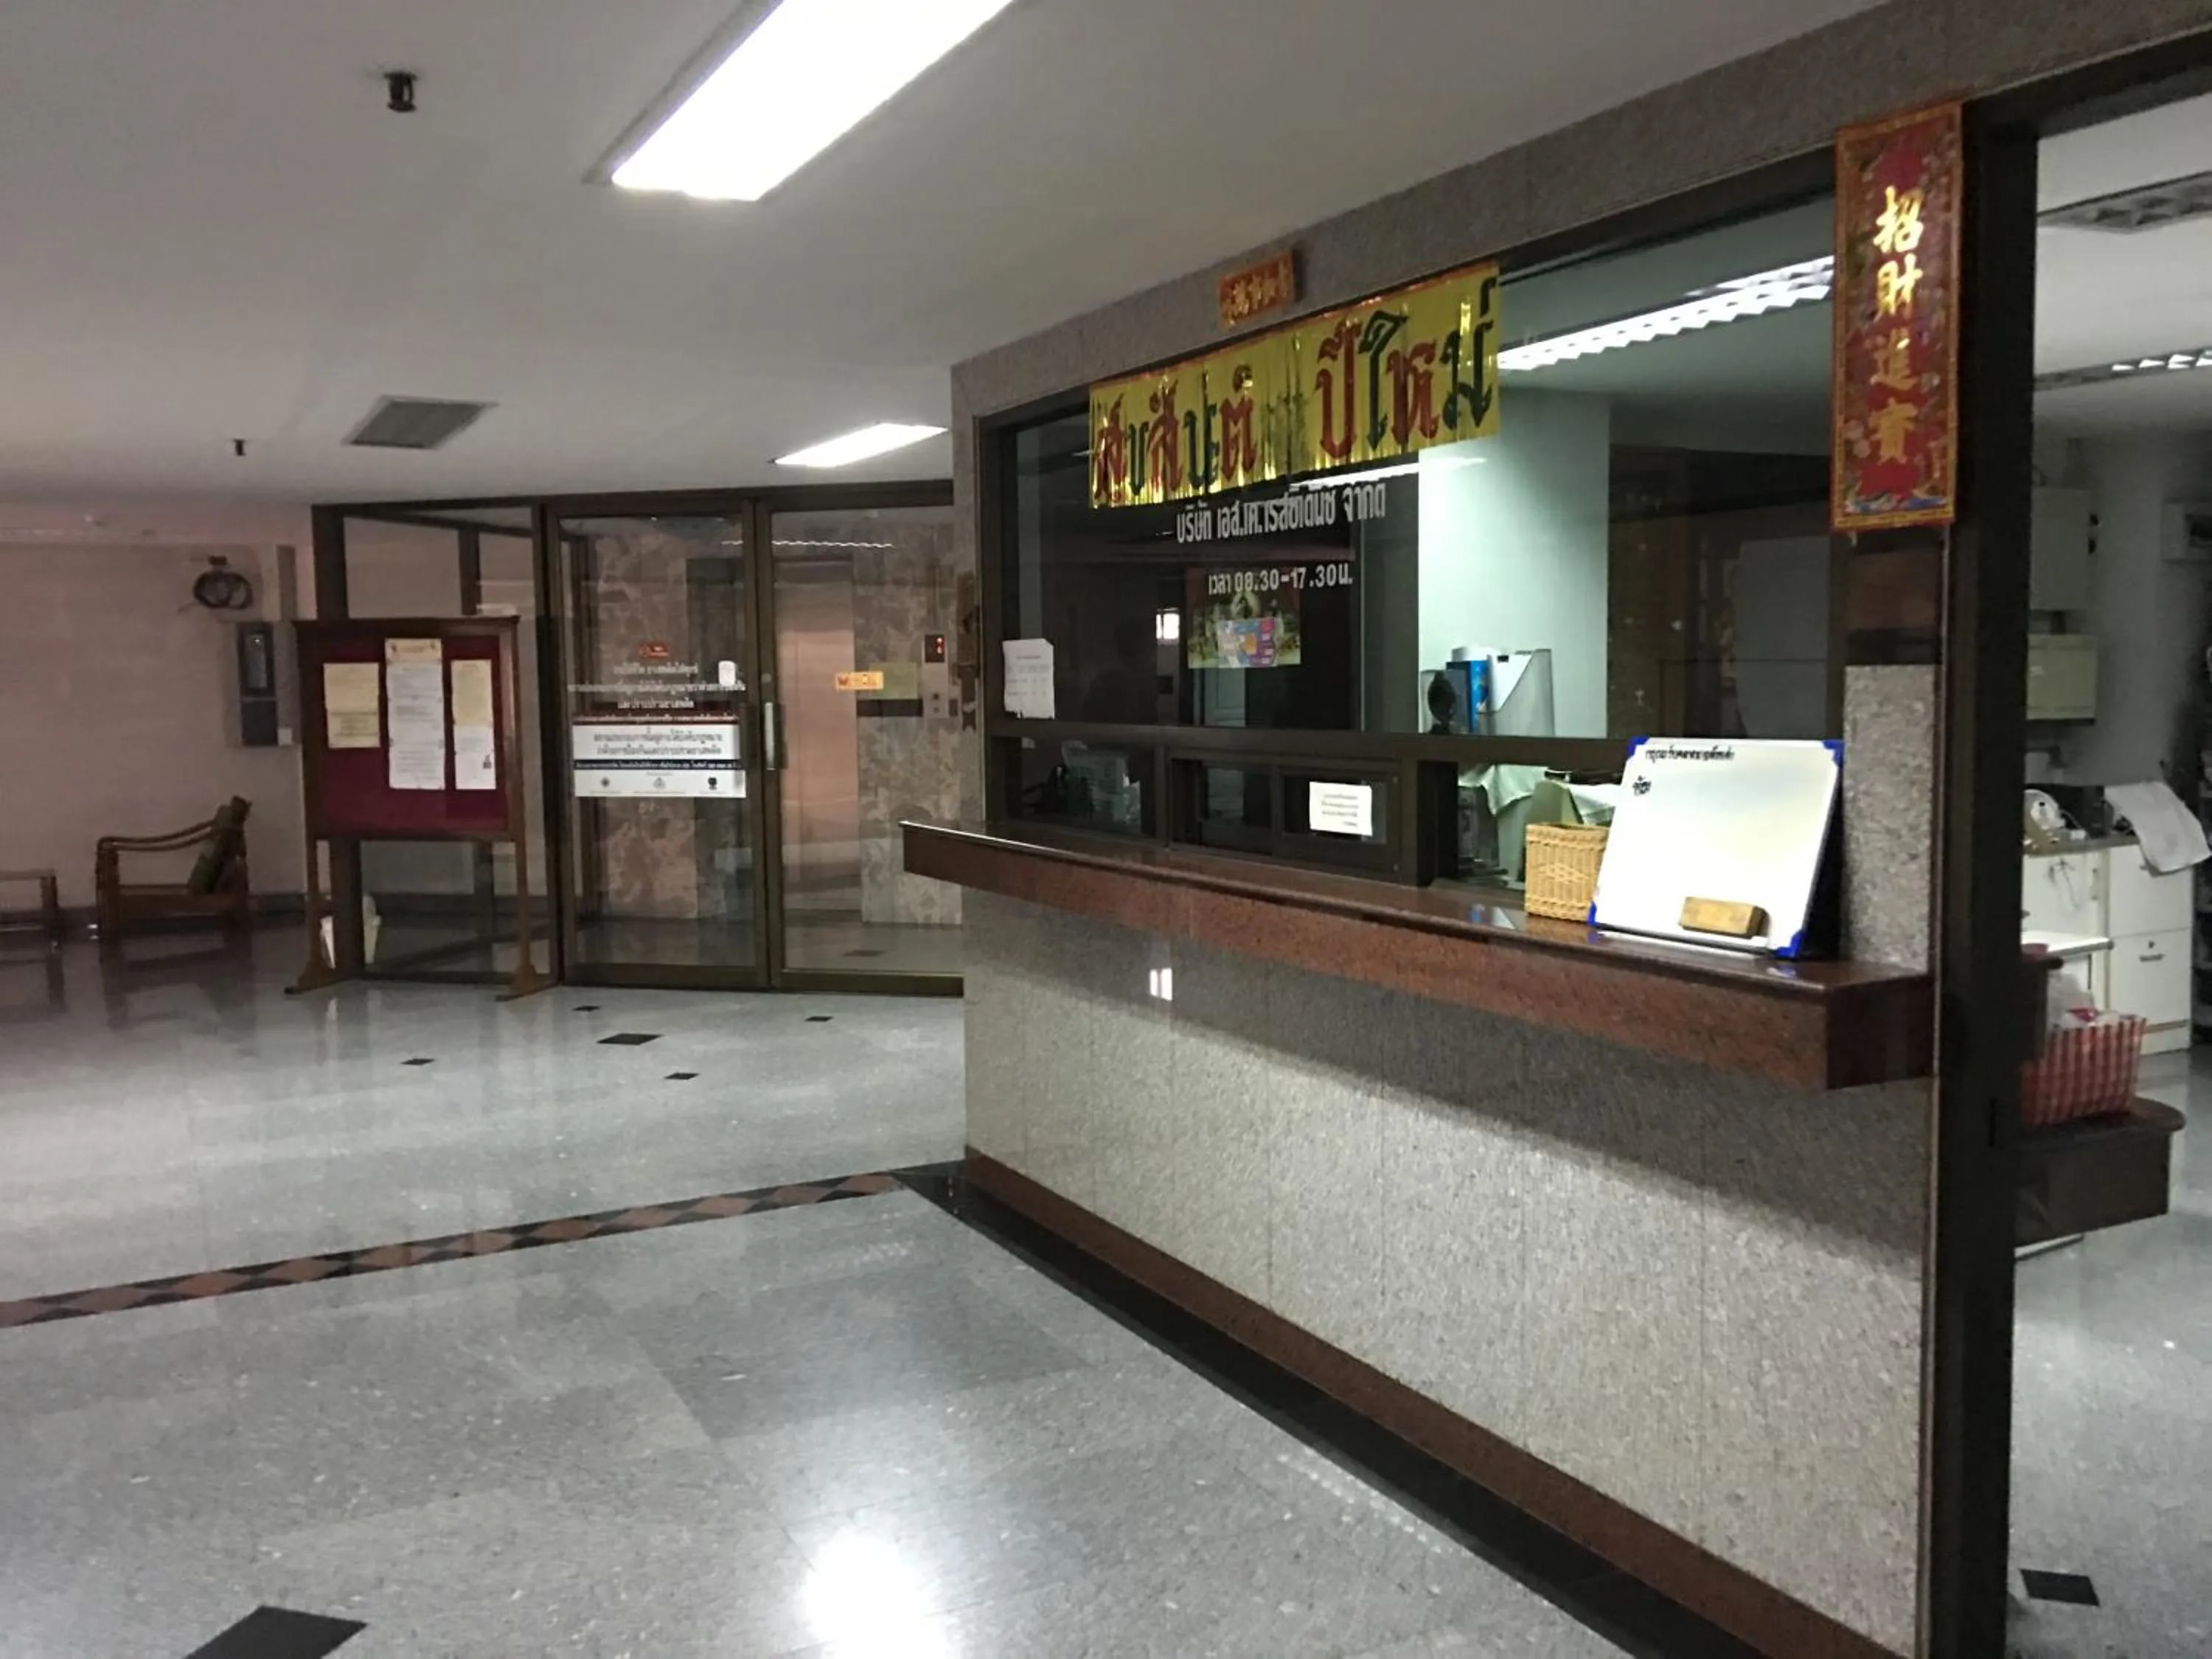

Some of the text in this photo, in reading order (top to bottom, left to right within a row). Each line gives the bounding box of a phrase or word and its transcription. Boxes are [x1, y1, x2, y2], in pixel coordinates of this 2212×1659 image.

[1315, 277, 1497, 458] ปีใหม่
[1176, 500, 1212, 543] บริษัท
